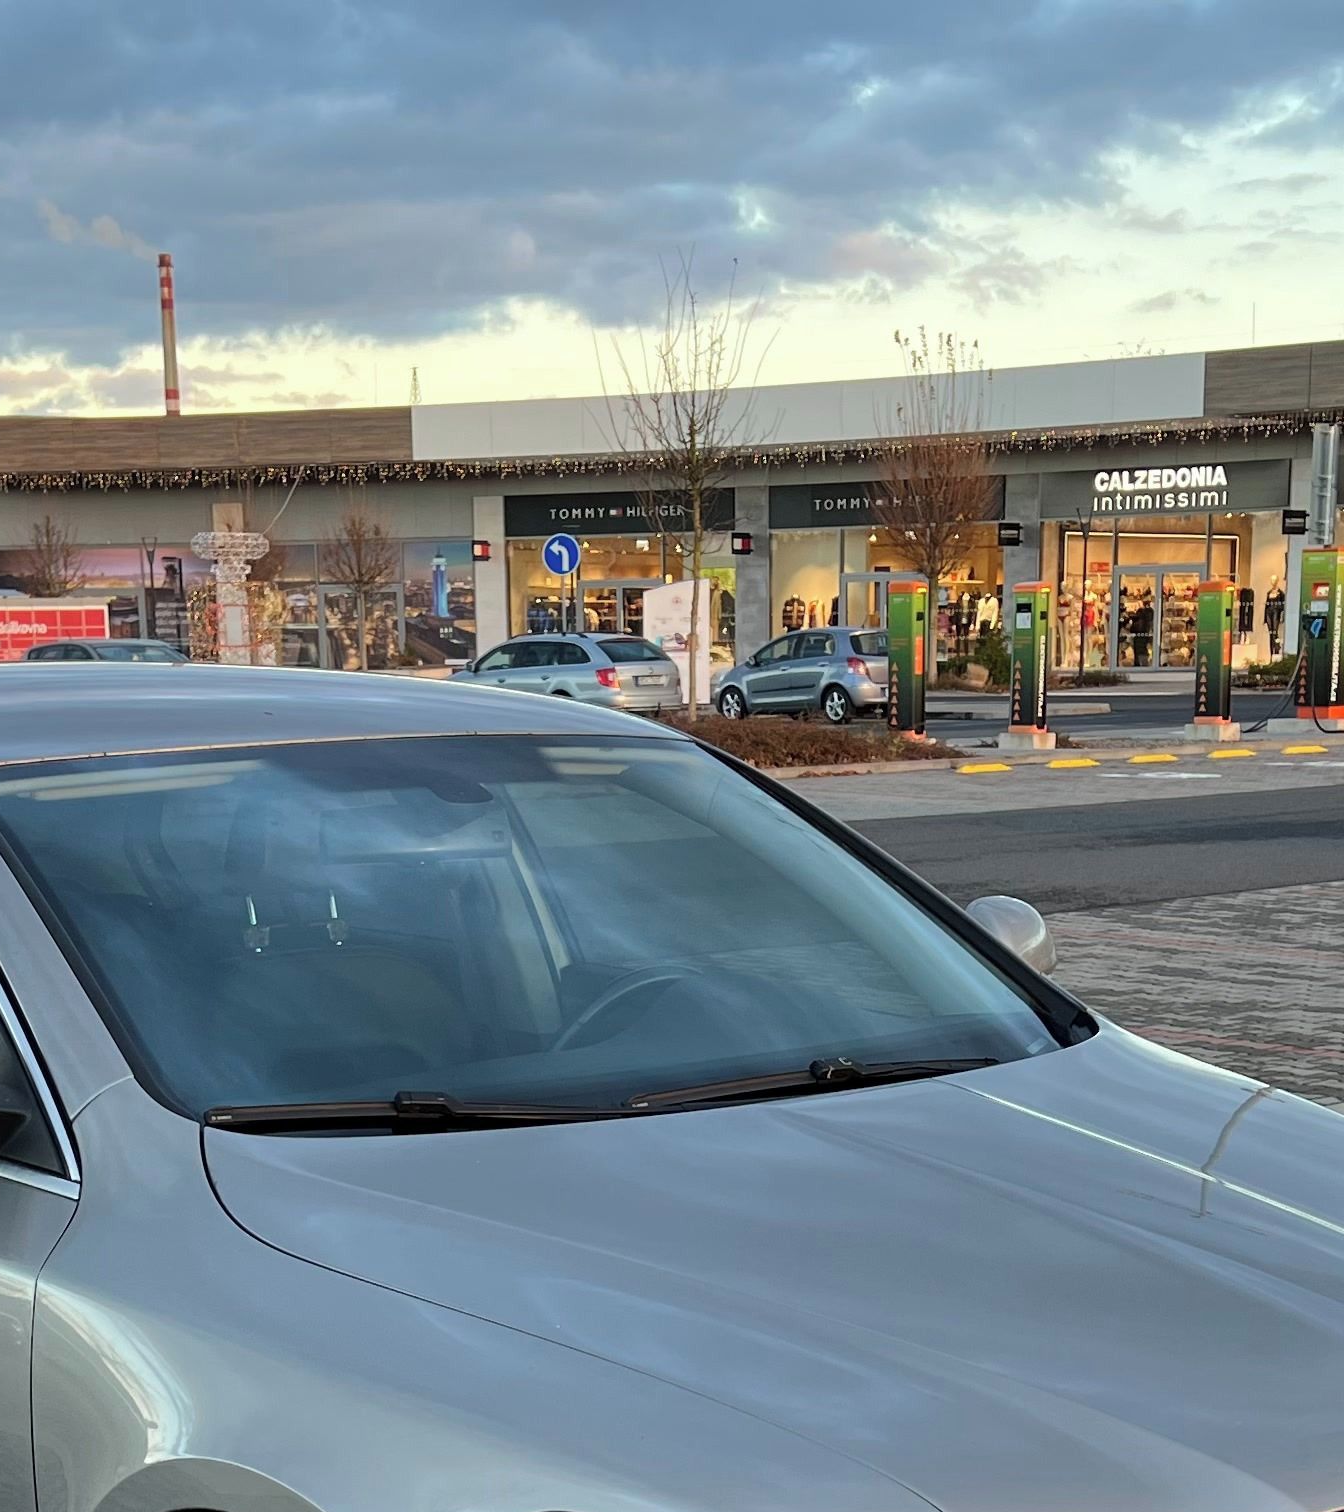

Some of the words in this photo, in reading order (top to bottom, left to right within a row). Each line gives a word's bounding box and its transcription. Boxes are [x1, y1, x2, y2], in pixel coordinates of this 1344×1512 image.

[1094, 465, 1228, 492] CALZEDONIA
[814, 497, 870, 511] TOMMY
[1093, 490, 1228, 512] intimissimi
[549, 507, 605, 520] TOMMY
